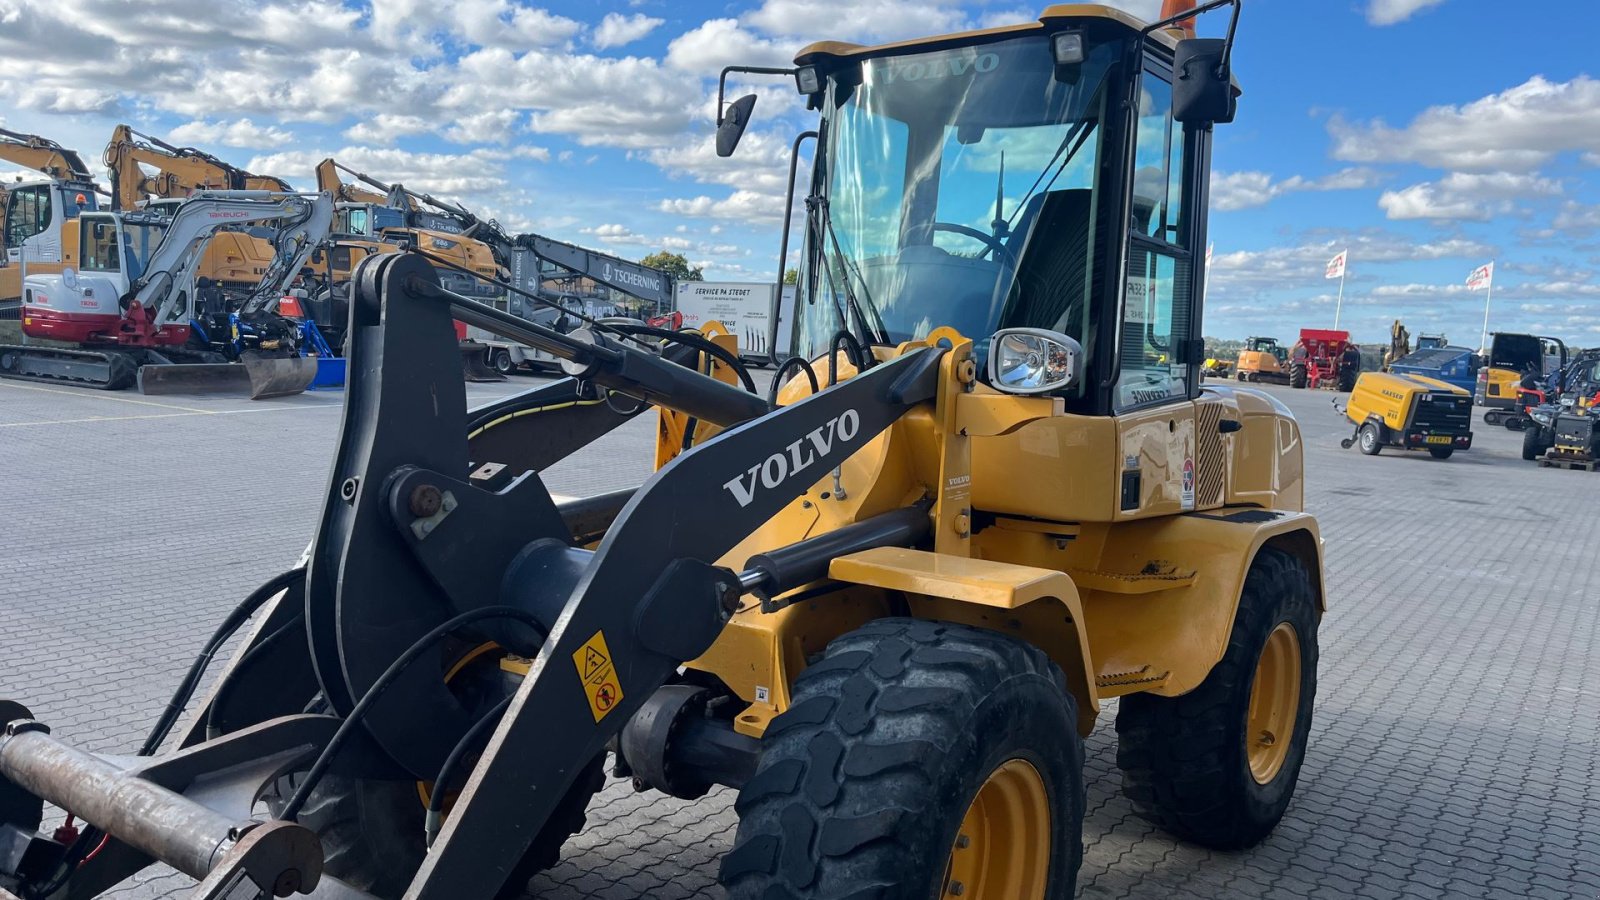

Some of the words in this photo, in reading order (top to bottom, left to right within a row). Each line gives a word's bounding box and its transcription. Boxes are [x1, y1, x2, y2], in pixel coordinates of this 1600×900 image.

[877, 53, 1000, 84] VOLVO
[207, 211, 249, 219] TAKEUCHI
[514, 252, 523, 298] TCHERNING
[613, 268, 661, 292] TSCHERNING
[1382, 389, 1404, 400] KAESER
[723, 408, 860, 508] VOLVO
[949, 475, 970, 486] VOLVO
